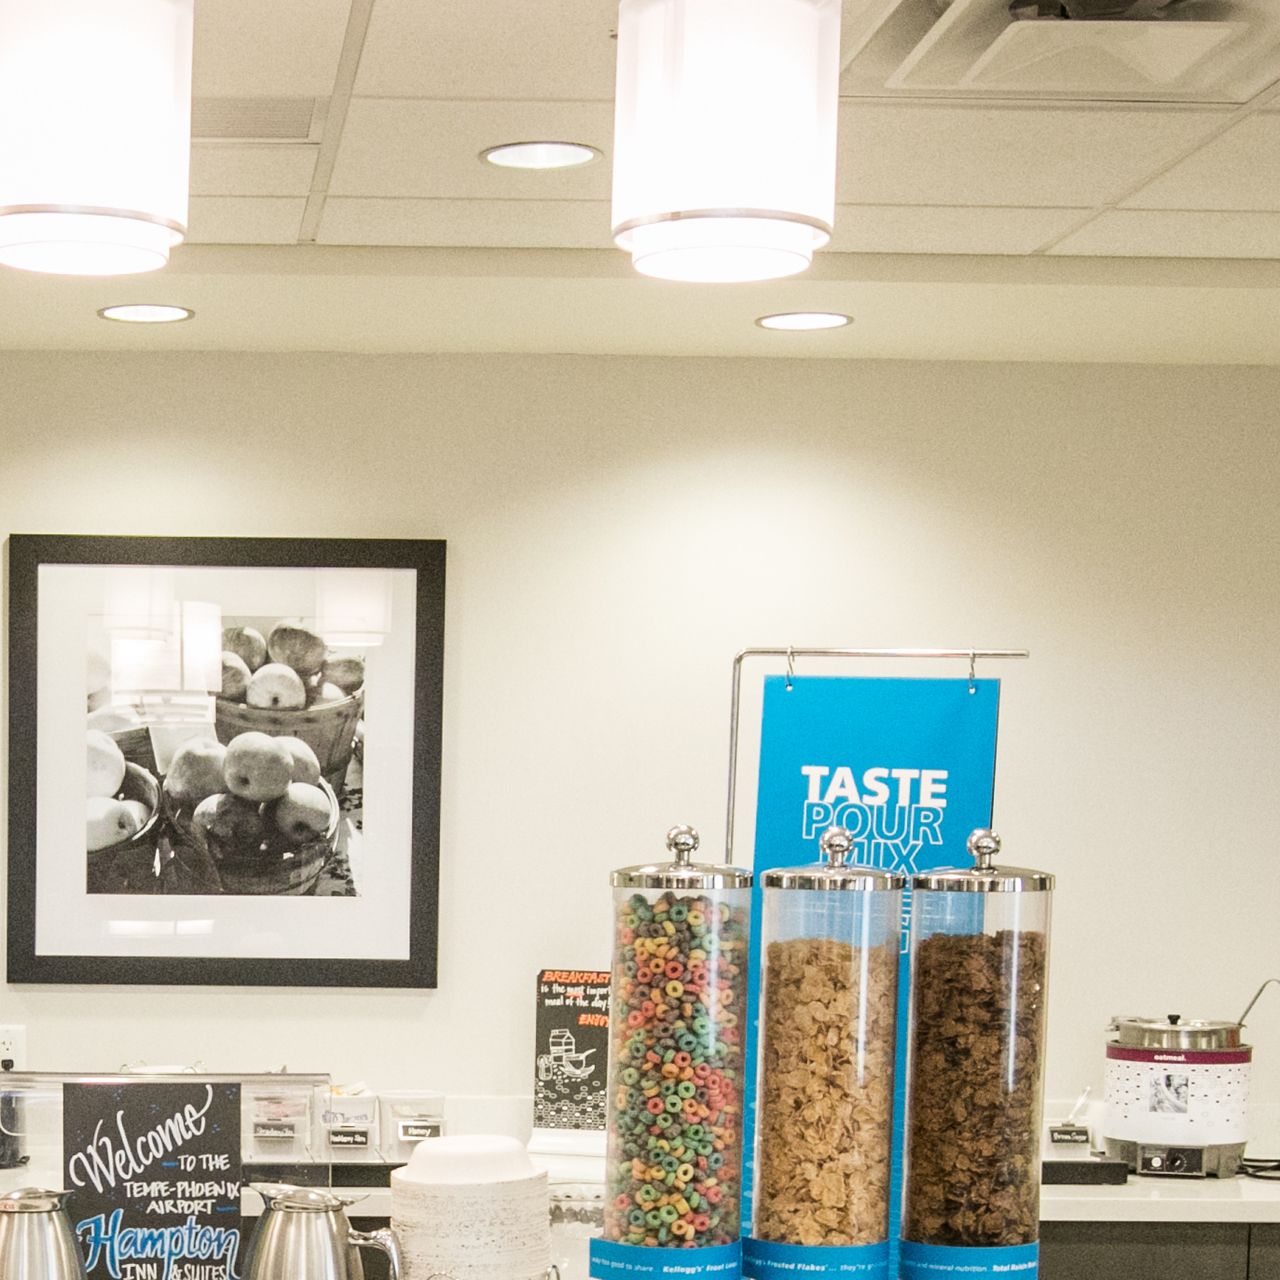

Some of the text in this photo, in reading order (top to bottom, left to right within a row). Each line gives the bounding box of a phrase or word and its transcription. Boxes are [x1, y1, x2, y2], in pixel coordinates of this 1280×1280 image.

[801, 765, 949, 808] TASTE
[802, 800, 944, 845] POUR
[542, 971, 611, 984] BREAKFAST
[541, 983, 549, 993] is
[552, 983, 566, 994] the
[545, 995, 564, 1006] meal
[565, 996, 574, 1006] of
[576, 996, 589, 1007] the
[1153, 1054, 1187, 1062] oatmeal.
[69, 1084, 213, 1194] Welcome
[178, 1154, 230, 1172] TO THE
[146, 1200, 216, 1215] AIRPORT
[122, 1263, 158, 1280] INN
